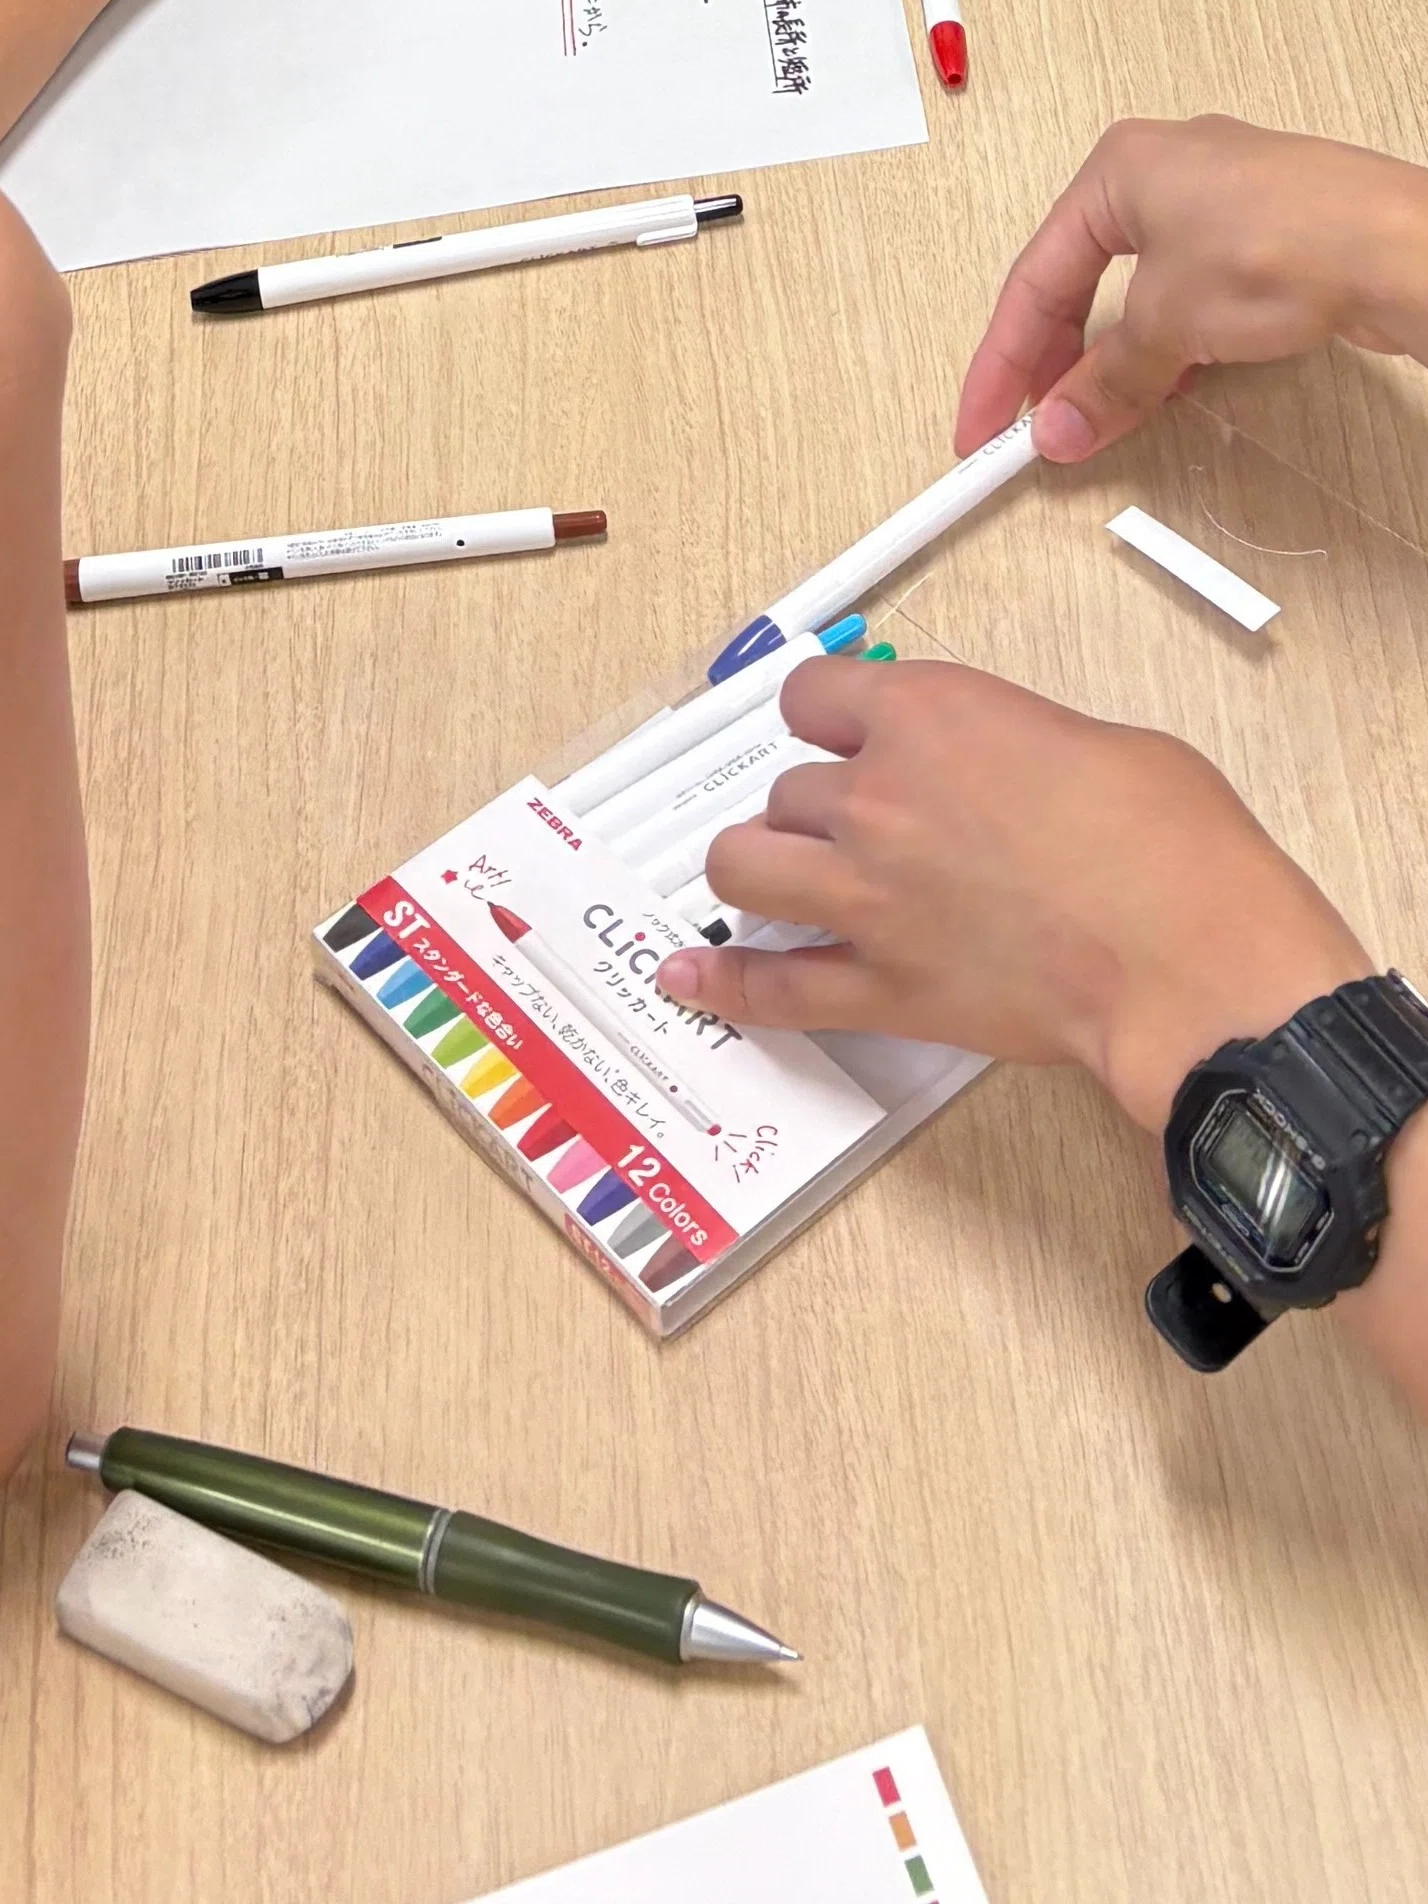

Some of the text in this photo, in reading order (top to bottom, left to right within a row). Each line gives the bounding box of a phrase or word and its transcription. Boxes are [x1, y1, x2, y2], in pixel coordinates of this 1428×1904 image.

[702, 739, 779, 794] CLICKART
[523, 794, 586, 853] ZEBRA
[591, 956, 672, 1039] クリッカート
[379, 895, 713, 1249] ST スタンダードな色合い 12 Colors
